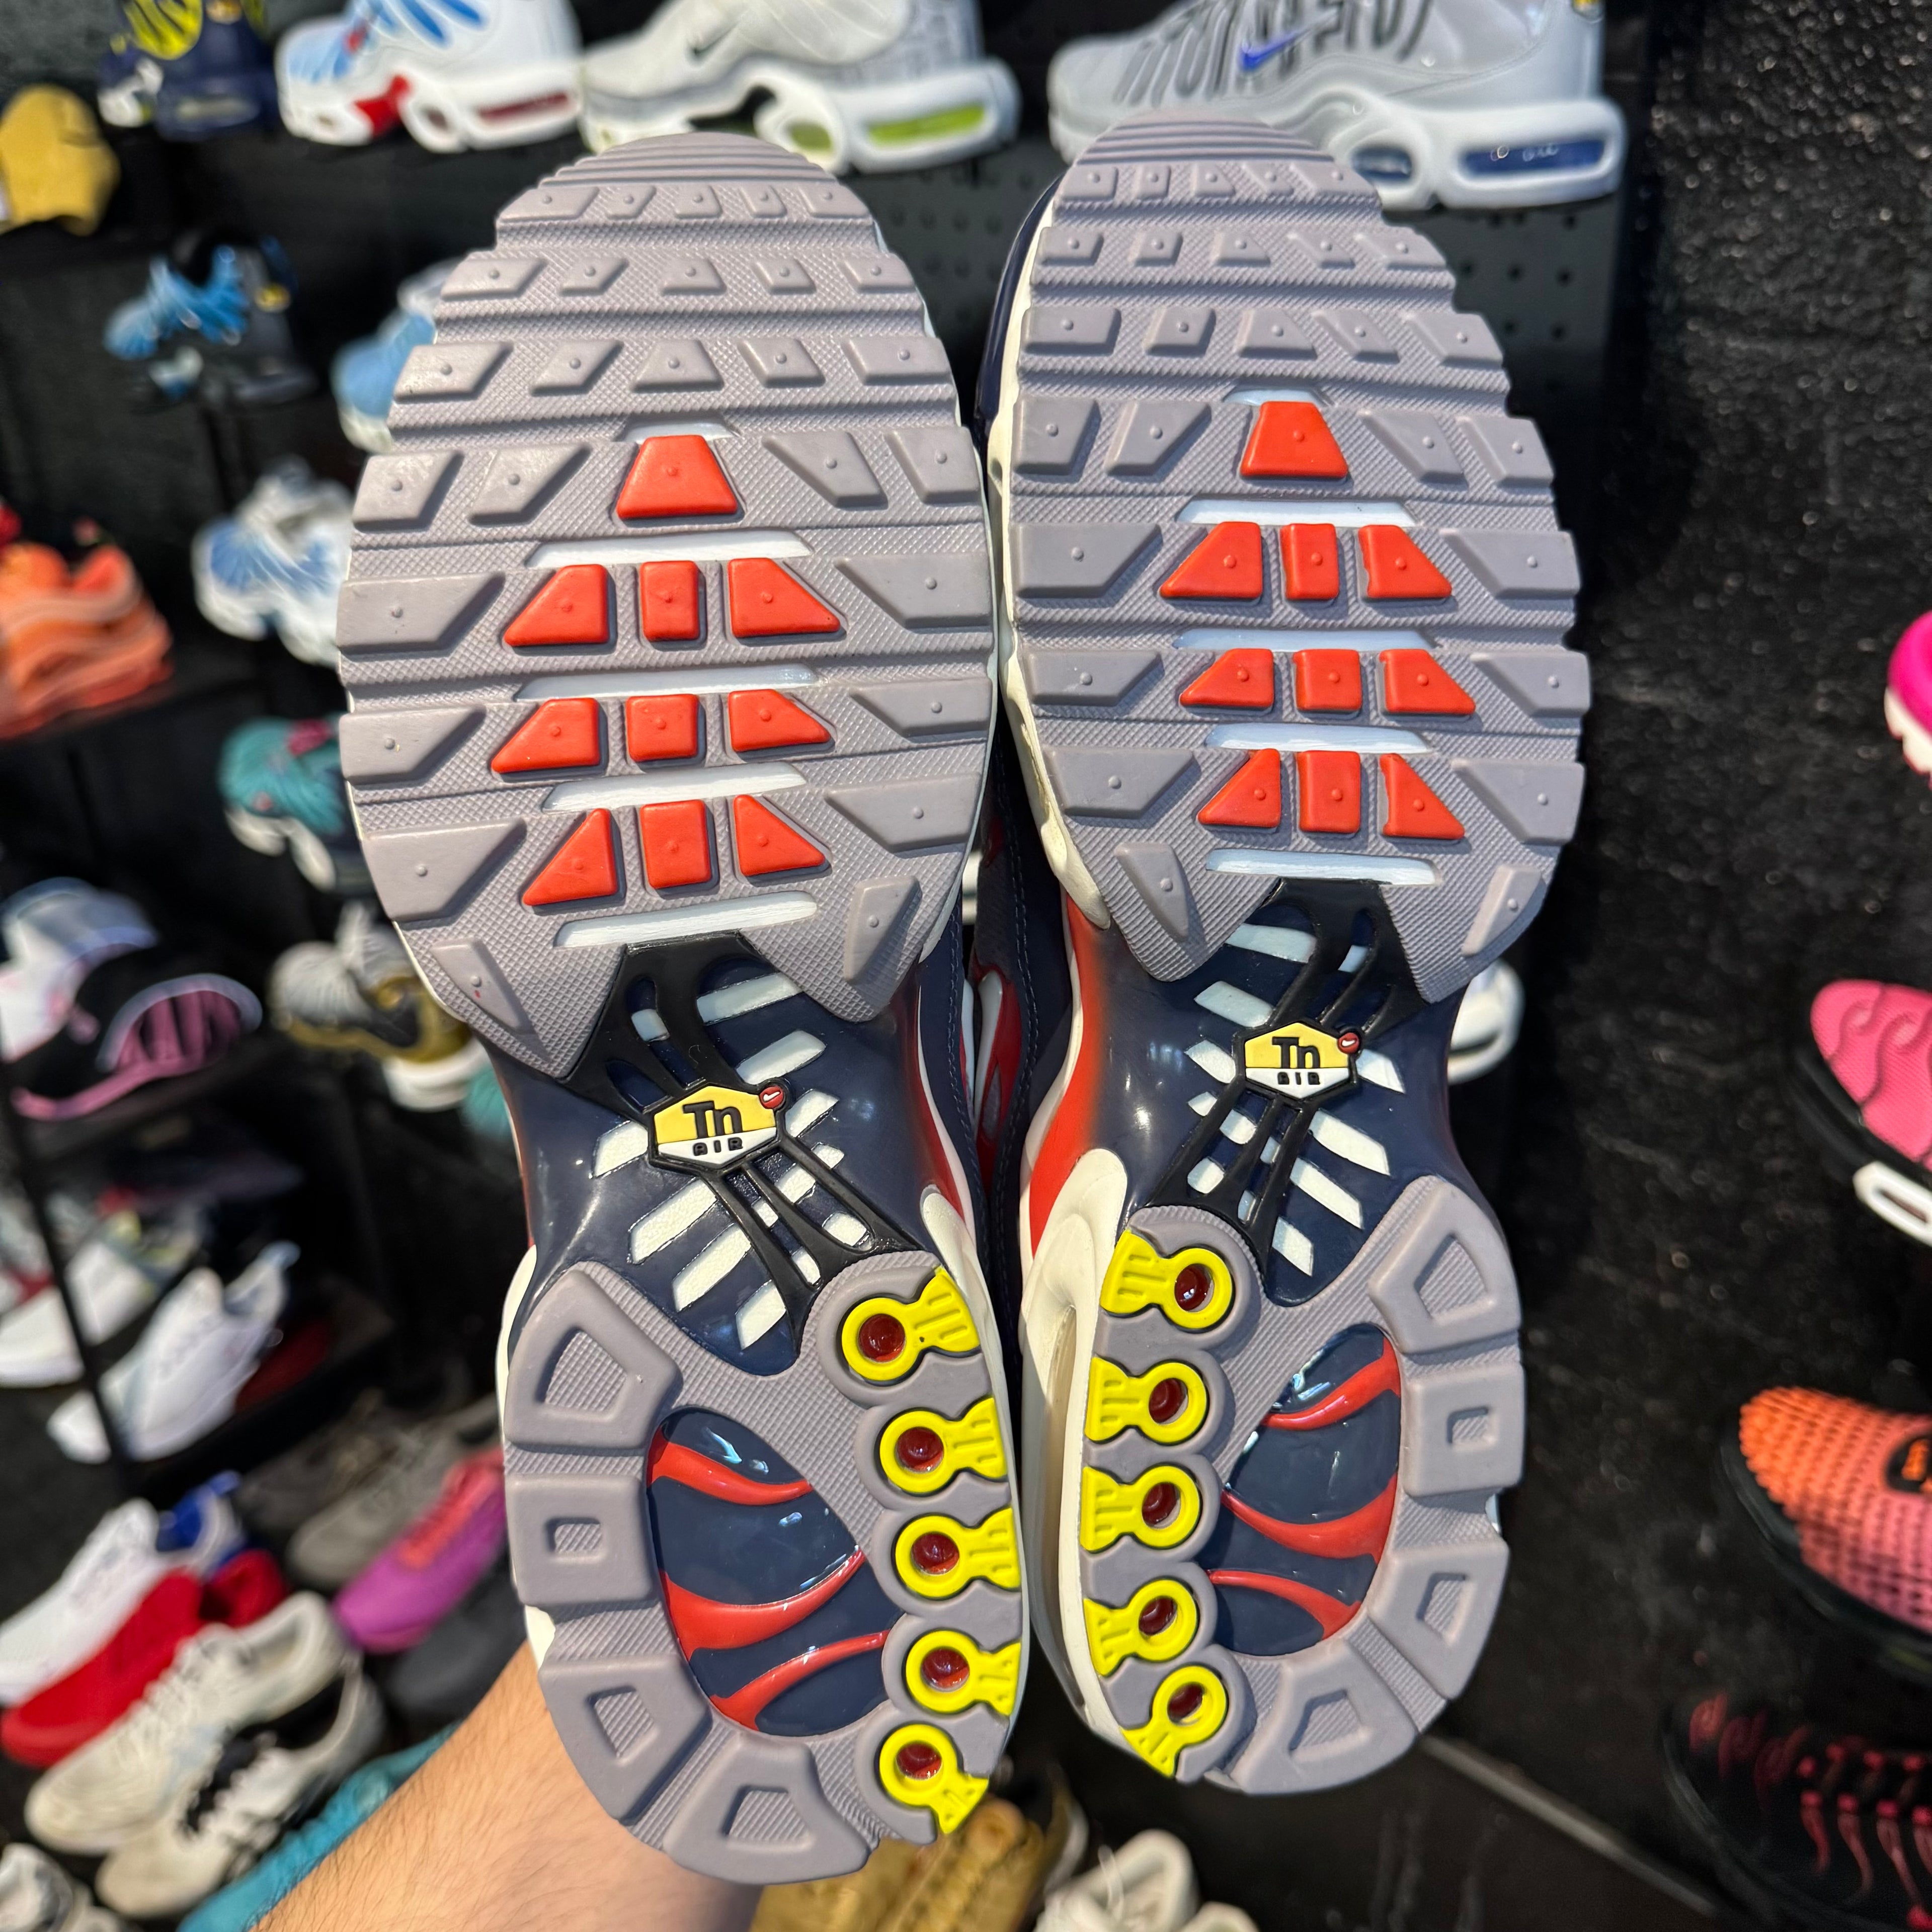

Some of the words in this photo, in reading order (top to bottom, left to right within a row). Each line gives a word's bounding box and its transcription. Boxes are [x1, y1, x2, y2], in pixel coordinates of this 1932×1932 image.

[1272, 1036, 1320, 1069] Tn
[682, 1100, 743, 1139] Tn
[693, 1137, 743, 1156] AIR
